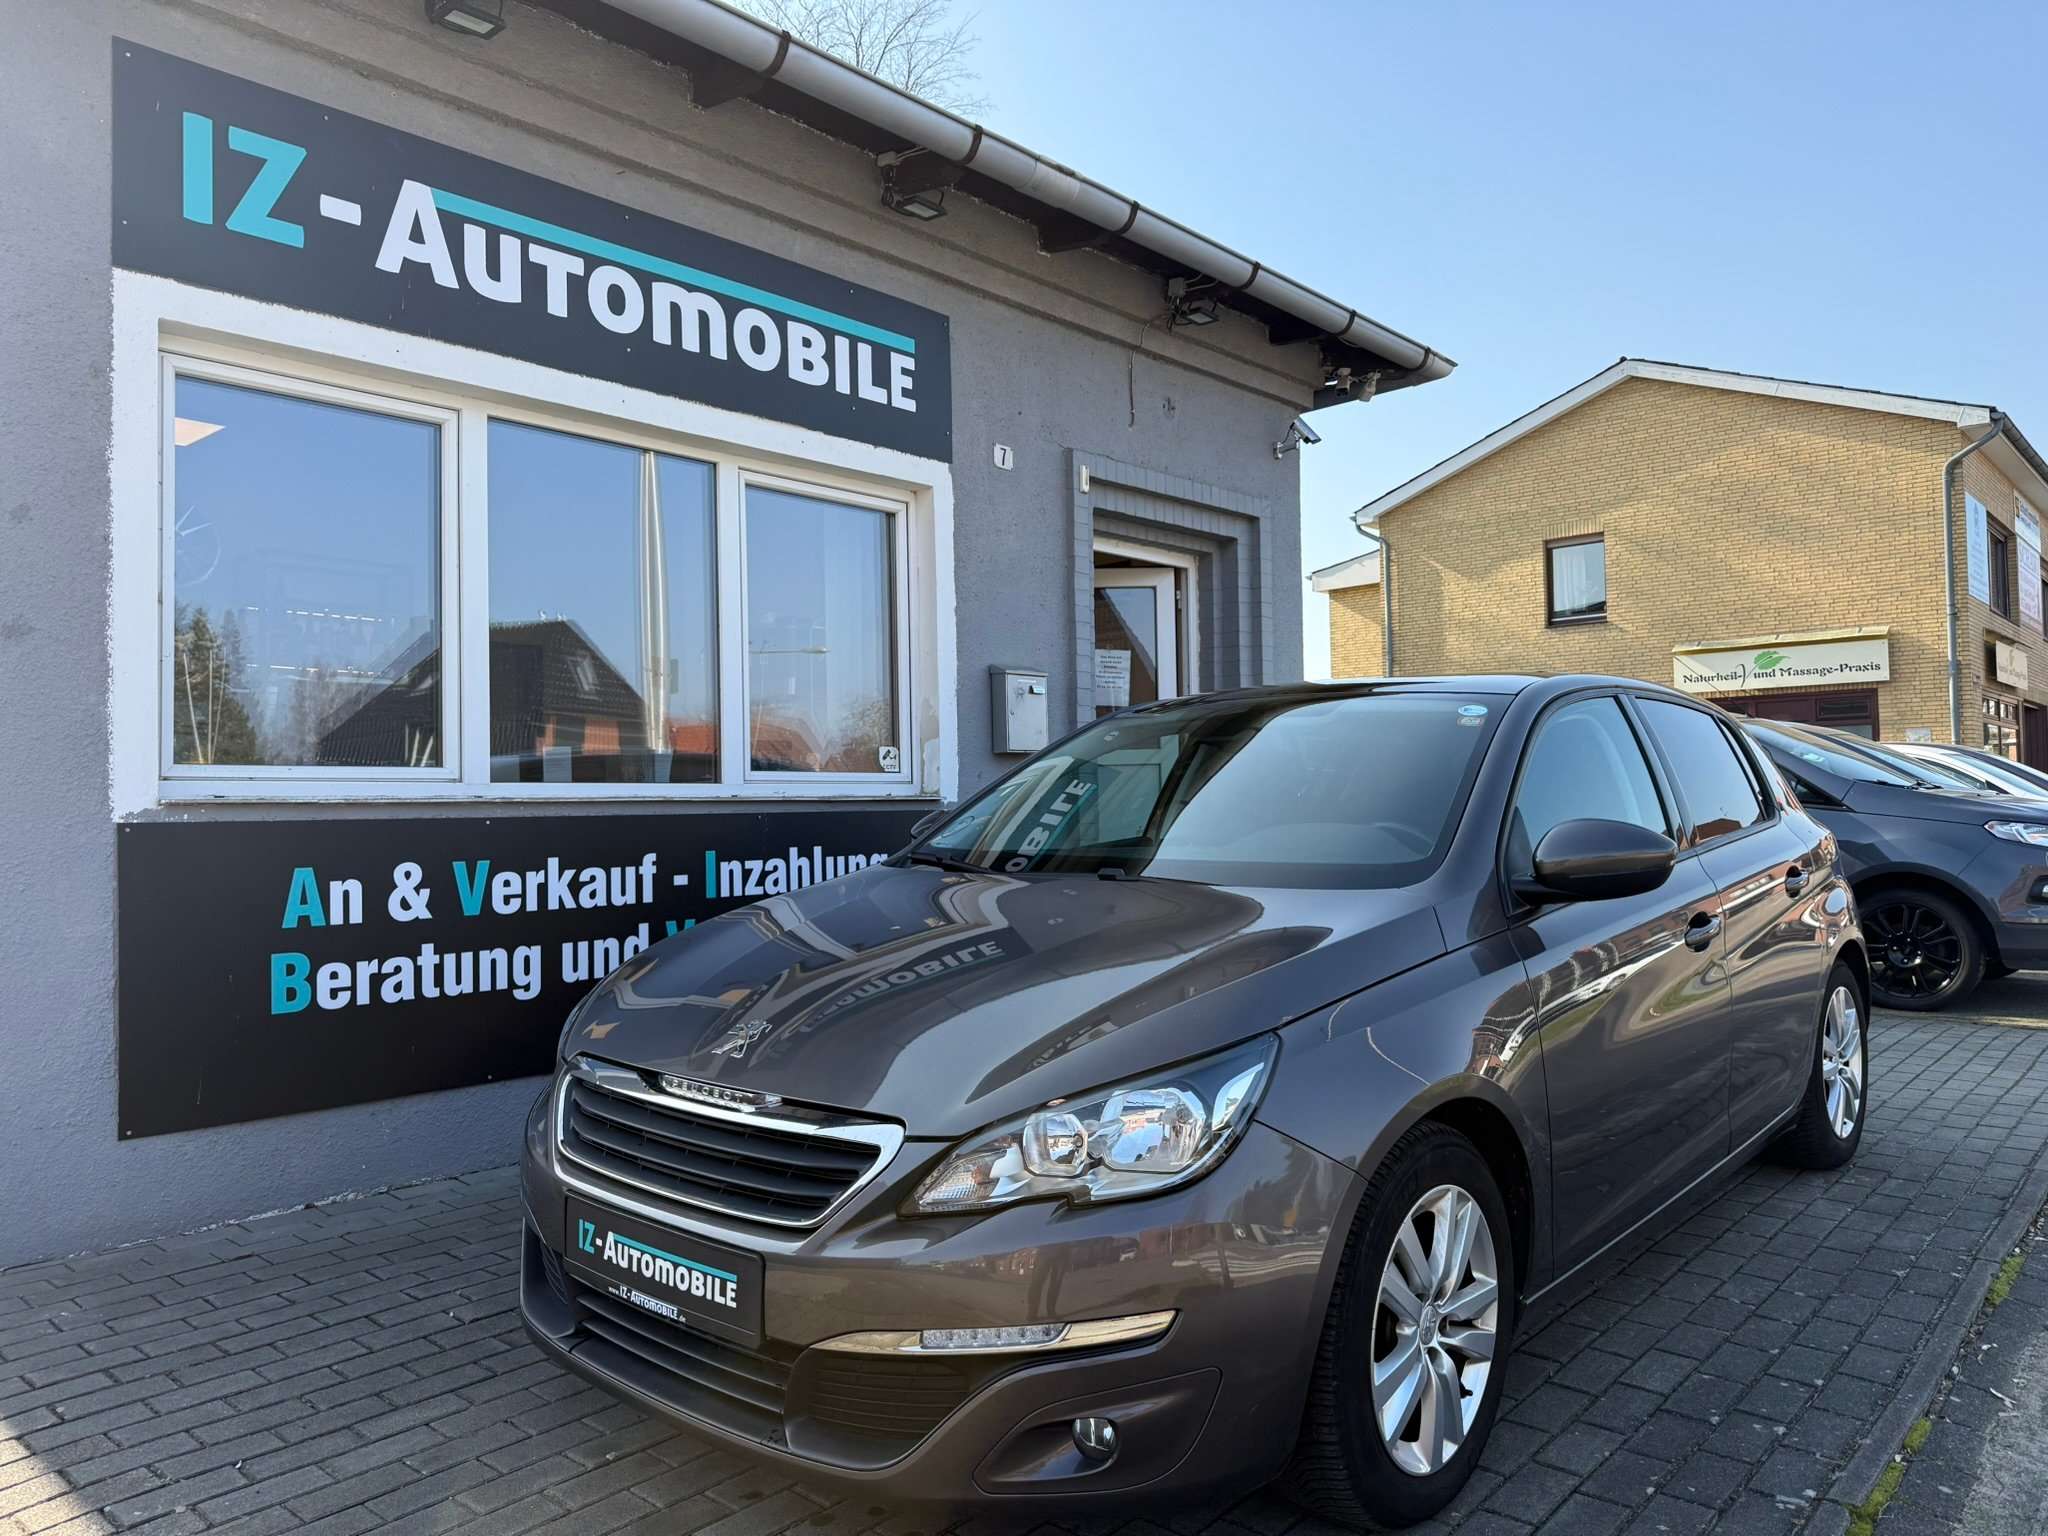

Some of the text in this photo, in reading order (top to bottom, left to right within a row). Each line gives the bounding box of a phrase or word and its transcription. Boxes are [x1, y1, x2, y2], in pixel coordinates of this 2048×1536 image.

[999, 447, 1008, 467] 7
[1753, 668, 1776, 679] und
[1779, 661, 1881, 677] Massage-Praxis
[281, 866, 363, 929] An
[387, 861, 432, 923] &
[452, 853, 657, 917] Verkauf
[673, 872, 689, 887] -
[270, 939, 543, 1015] Beratung
